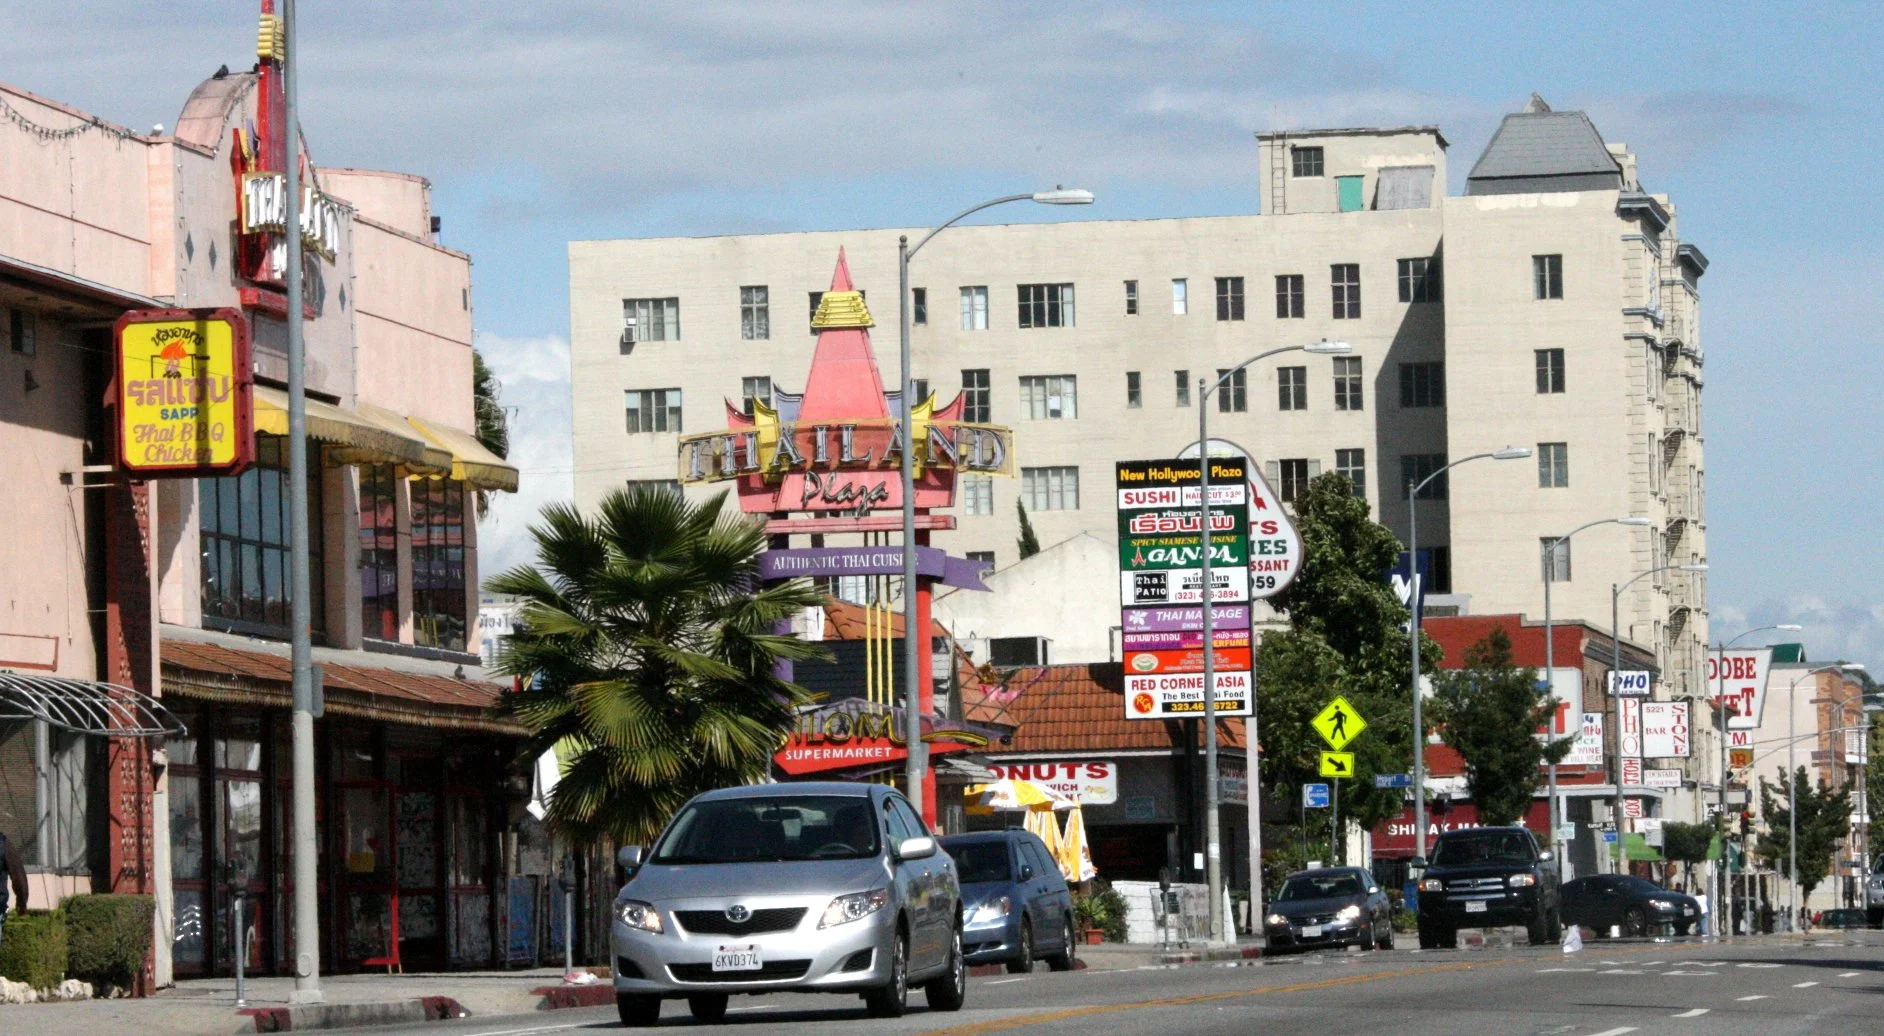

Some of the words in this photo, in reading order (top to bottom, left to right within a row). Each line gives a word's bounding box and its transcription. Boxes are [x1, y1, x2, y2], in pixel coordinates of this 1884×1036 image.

[160, 407, 200, 421] SAPP
[133, 423, 176, 444] Thai
[144, 443, 214, 463] Chicken
[680, 422, 1006, 480] THAILAND
[1120, 469, 1145, 481] New
[1148, 467, 1202, 483] Hollywoo
[1211, 465, 1243, 477] Plaza
[802, 470, 889, 519] Plaza
[1124, 491, 1176, 504] SUSHI
[1162, 510, 1225, 518] ห้องอาาร
[1130, 538, 1156, 547] SPICY
[1160, 536, 1199, 546] SIAMESE
[773, 555, 840, 570] AUTHENTIC
[842, 554, 870, 568] THAI
[873, 553, 919, 567] CUISIE
[1147, 545, 1239, 566] GANDA
[1136, 575, 1166, 585] Thai
[1136, 588, 1167, 596] PATIO
[1175, 591, 1196, 600] (323)
[1199, 590, 1239, 599] 46-3894
[1156, 610, 1182, 622] THAI
[1185, 608, 1243, 621] MASAGE
[1211, 638, 1249, 648] ERFUME
[1708, 656, 1757, 680] DOBE
[1131, 679, 1156, 691] RED
[1160, 677, 1205, 690] CORNE
[1216, 676, 1245, 688] ASIA
[1613, 674, 1648, 689] PHO
[1162, 692, 1177, 700] The
[1180, 691, 1200, 700] Best
[1224, 690, 1244, 698] Food
[792, 711, 907, 746] ILOM
[1645, 727, 1666, 735] BAR
[1671, 704, 1687, 755] STONE
[785, 746, 893, 761] SUPERMARKET
[985, 762, 1109, 781] ONUTS
[1387, 822, 1450, 836] SHIAK
[715, 953, 759, 968] 6KVD374
